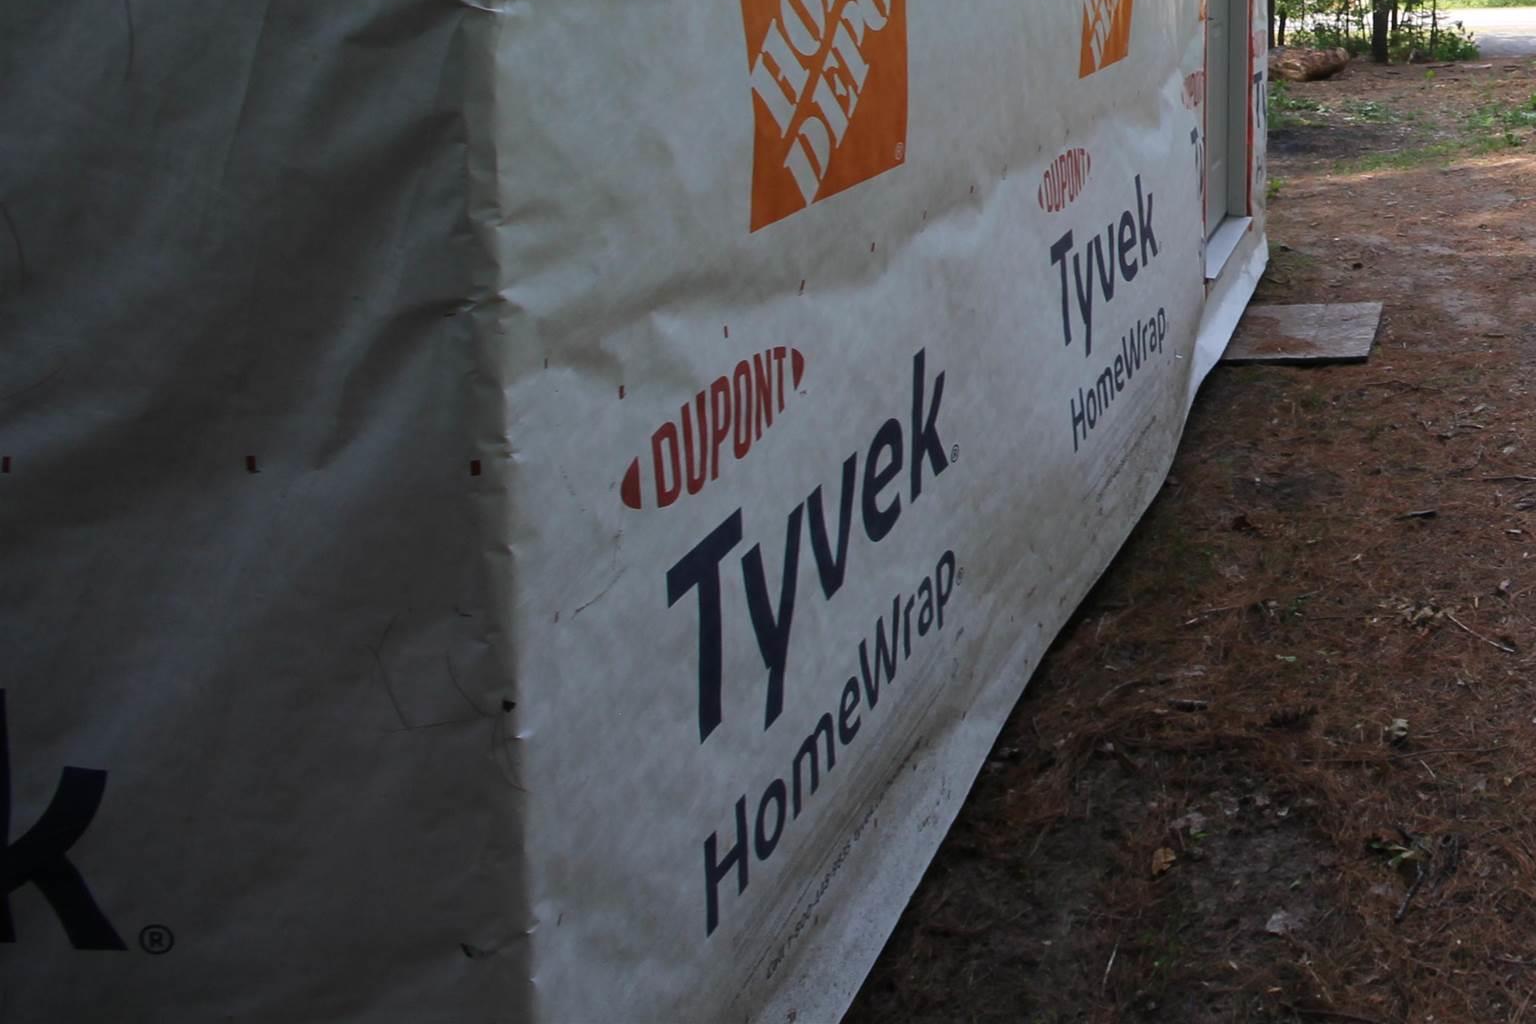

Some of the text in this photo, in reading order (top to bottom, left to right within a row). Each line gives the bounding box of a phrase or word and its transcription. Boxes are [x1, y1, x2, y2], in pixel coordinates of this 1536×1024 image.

[1045, 148, 1086, 213] DUPONT
[1050, 174, 1158, 358] Tyvek
[652, 346, 787, 509] DUPONT
[1070, 307, 1166, 453] HomeWrap
[666, 347, 949, 744] Tyvek
[704, 550, 956, 938] HomeWrap
